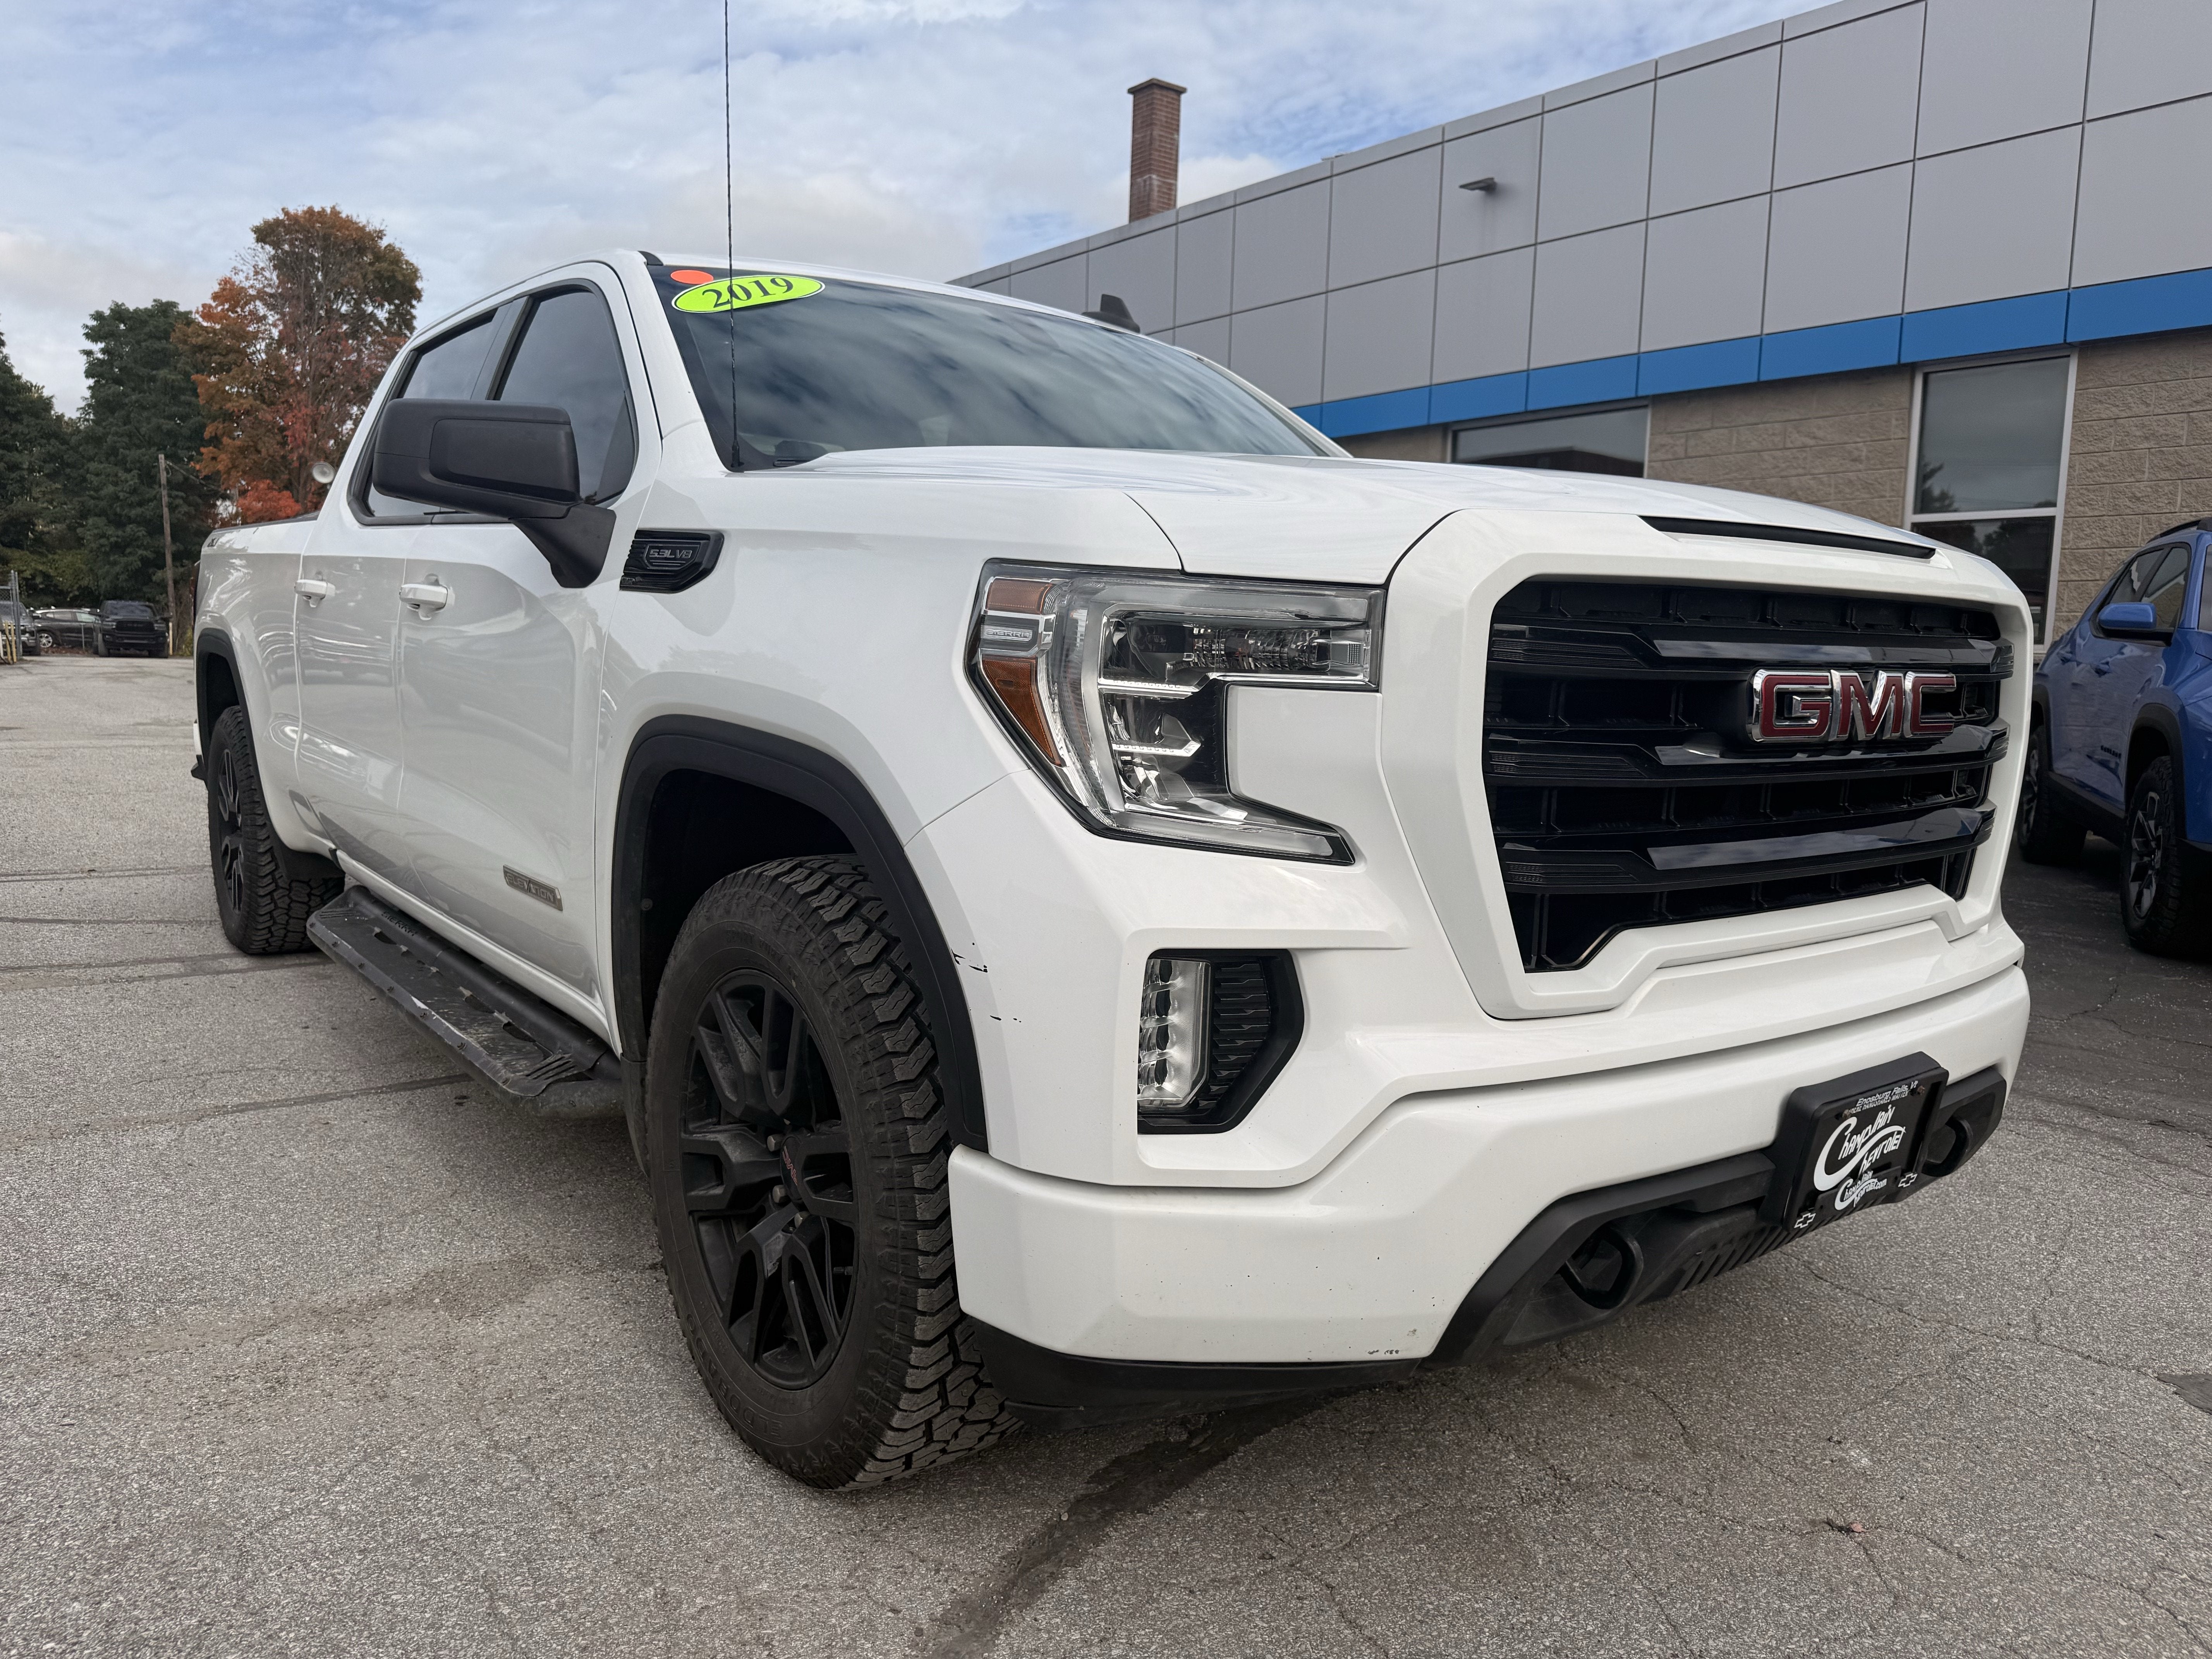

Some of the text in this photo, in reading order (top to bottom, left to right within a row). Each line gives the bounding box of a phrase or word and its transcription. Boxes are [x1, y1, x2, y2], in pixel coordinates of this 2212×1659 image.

[702, 277, 793, 308] 2019
[676, 550, 692, 558] V8
[985, 629, 1029, 638] SIERRA
[1752, 669, 1956, 742] GMC
[507, 873, 554, 902] ELEVATION
[1856, 1091, 1892, 1106] Enosburg
